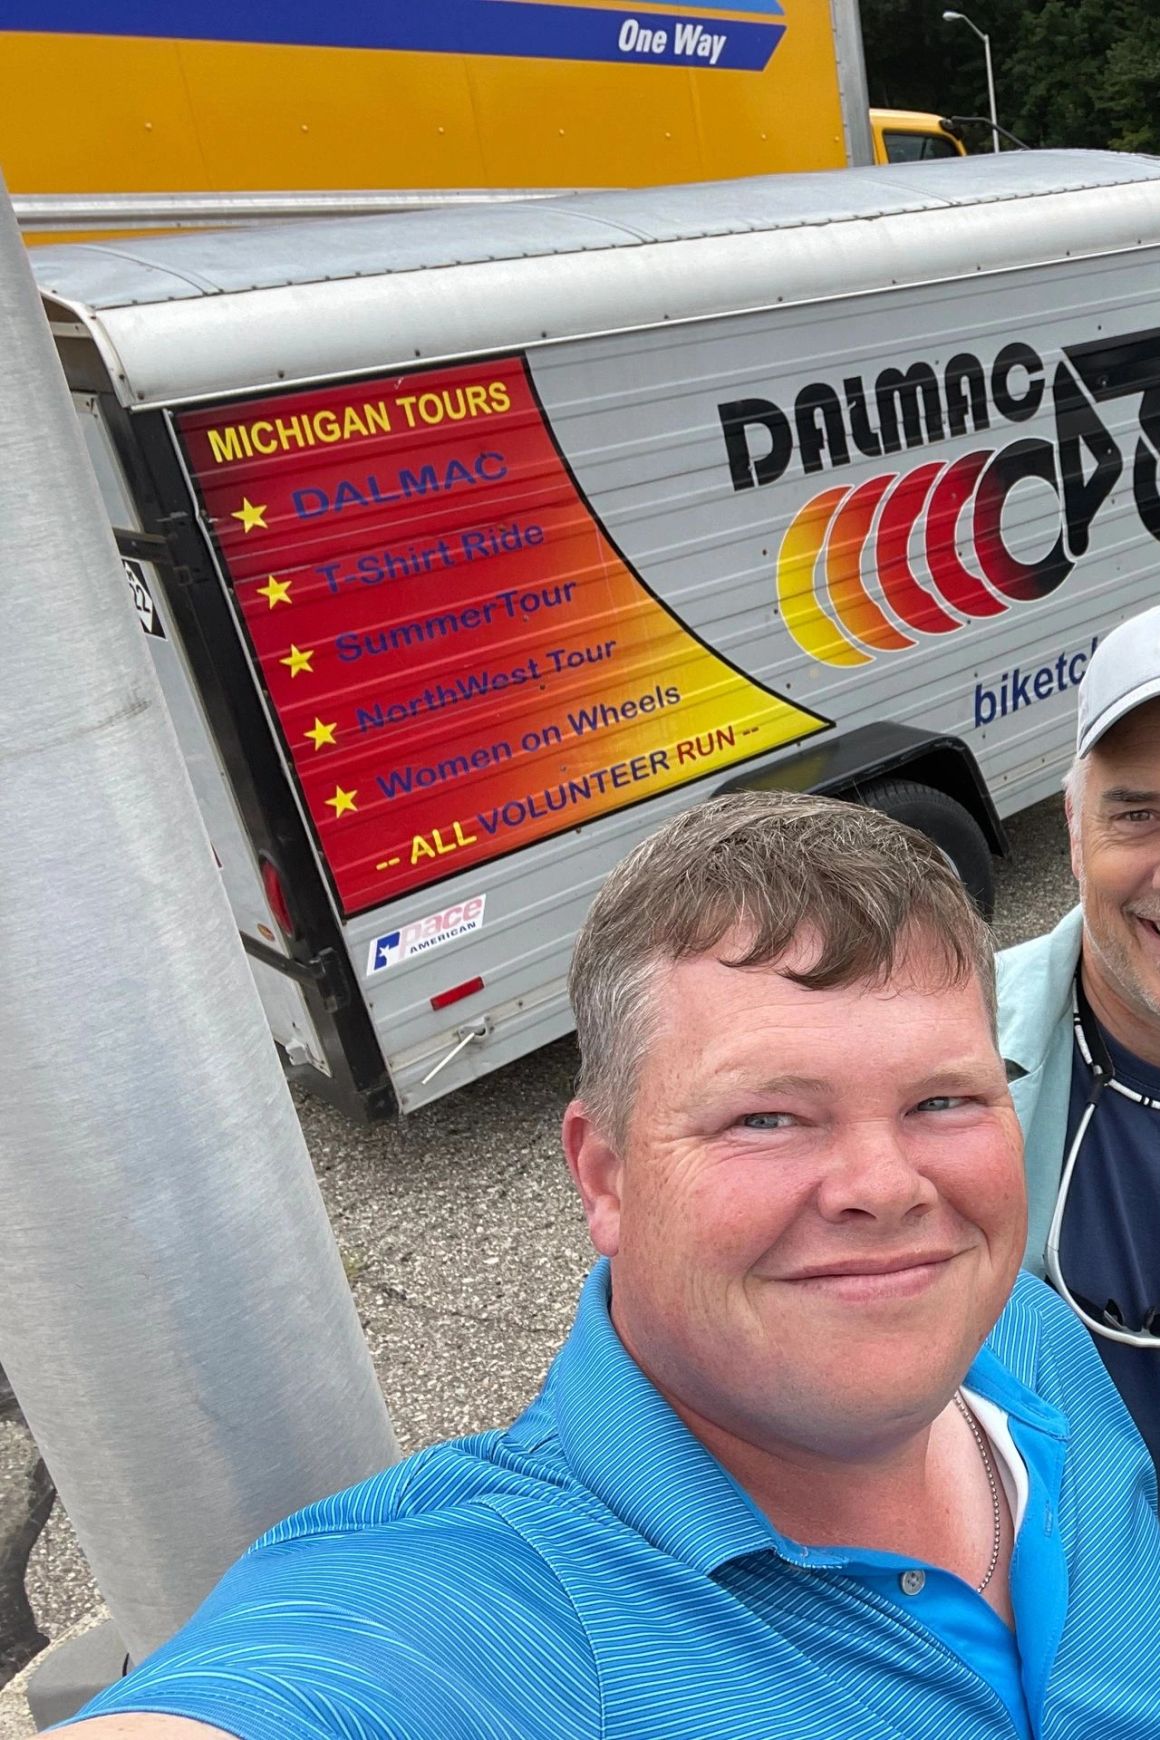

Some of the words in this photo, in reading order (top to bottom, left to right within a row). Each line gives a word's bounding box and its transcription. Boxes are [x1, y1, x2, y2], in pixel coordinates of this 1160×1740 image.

[618, 18, 667, 54] One
[673, 22, 727, 65] Way
[207, 401, 391, 463] MICHIGAN
[396, 381, 511, 427] TOURS
[717, 342, 1045, 491] DALMAC
[291, 451, 508, 519] DALMAC
[316, 540, 455, 593] T-Shirt
[461, 523, 544, 560] Ride
[335, 581, 576, 662] SummerTour
[356, 658, 541, 733] NorthWest
[546, 640, 616, 672] Tour
[378, 741, 513, 800] Women
[521, 725, 562, 752] on
[568, 684, 681, 736] Wheels
[411, 821, 478, 864] ALL
[477, 749, 670, 835] VOLUNTEER
[676, 725, 737, 766] RUN
[400, 898, 482, 957] pace
[410, 921, 476, 954] AMERICAN
